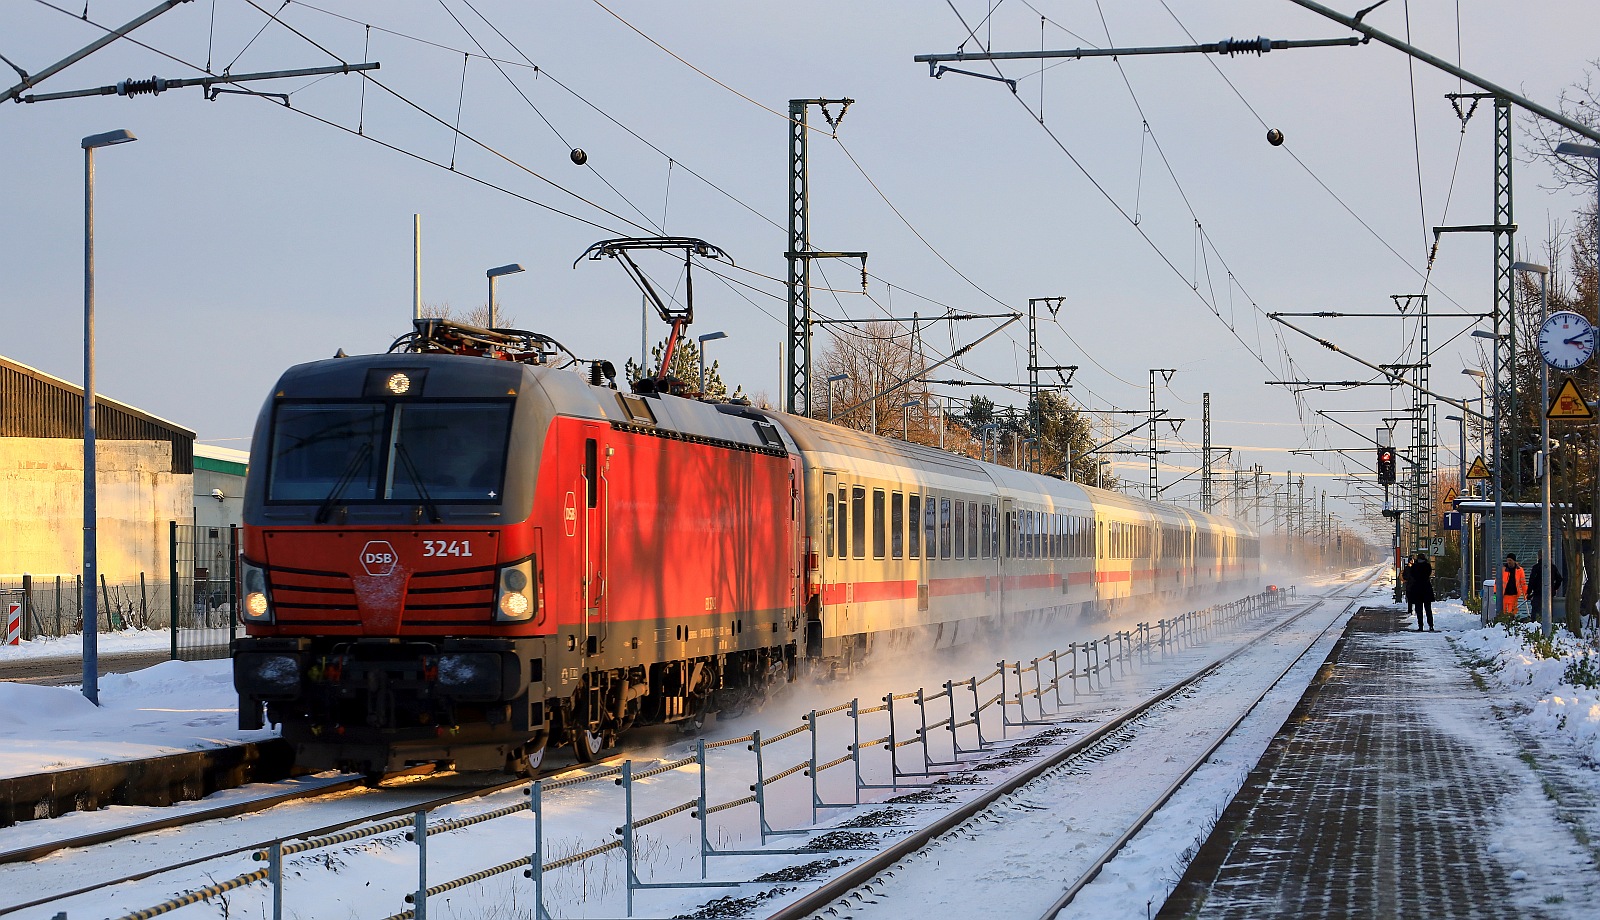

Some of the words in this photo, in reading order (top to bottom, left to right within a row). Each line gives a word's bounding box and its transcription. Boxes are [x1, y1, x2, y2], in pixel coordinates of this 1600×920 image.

[1446, 513, 1451, 526] 1
[423, 540, 472, 557] 3241
[1433, 547, 1439, 555] 2
[366, 553, 392, 564] DSB
